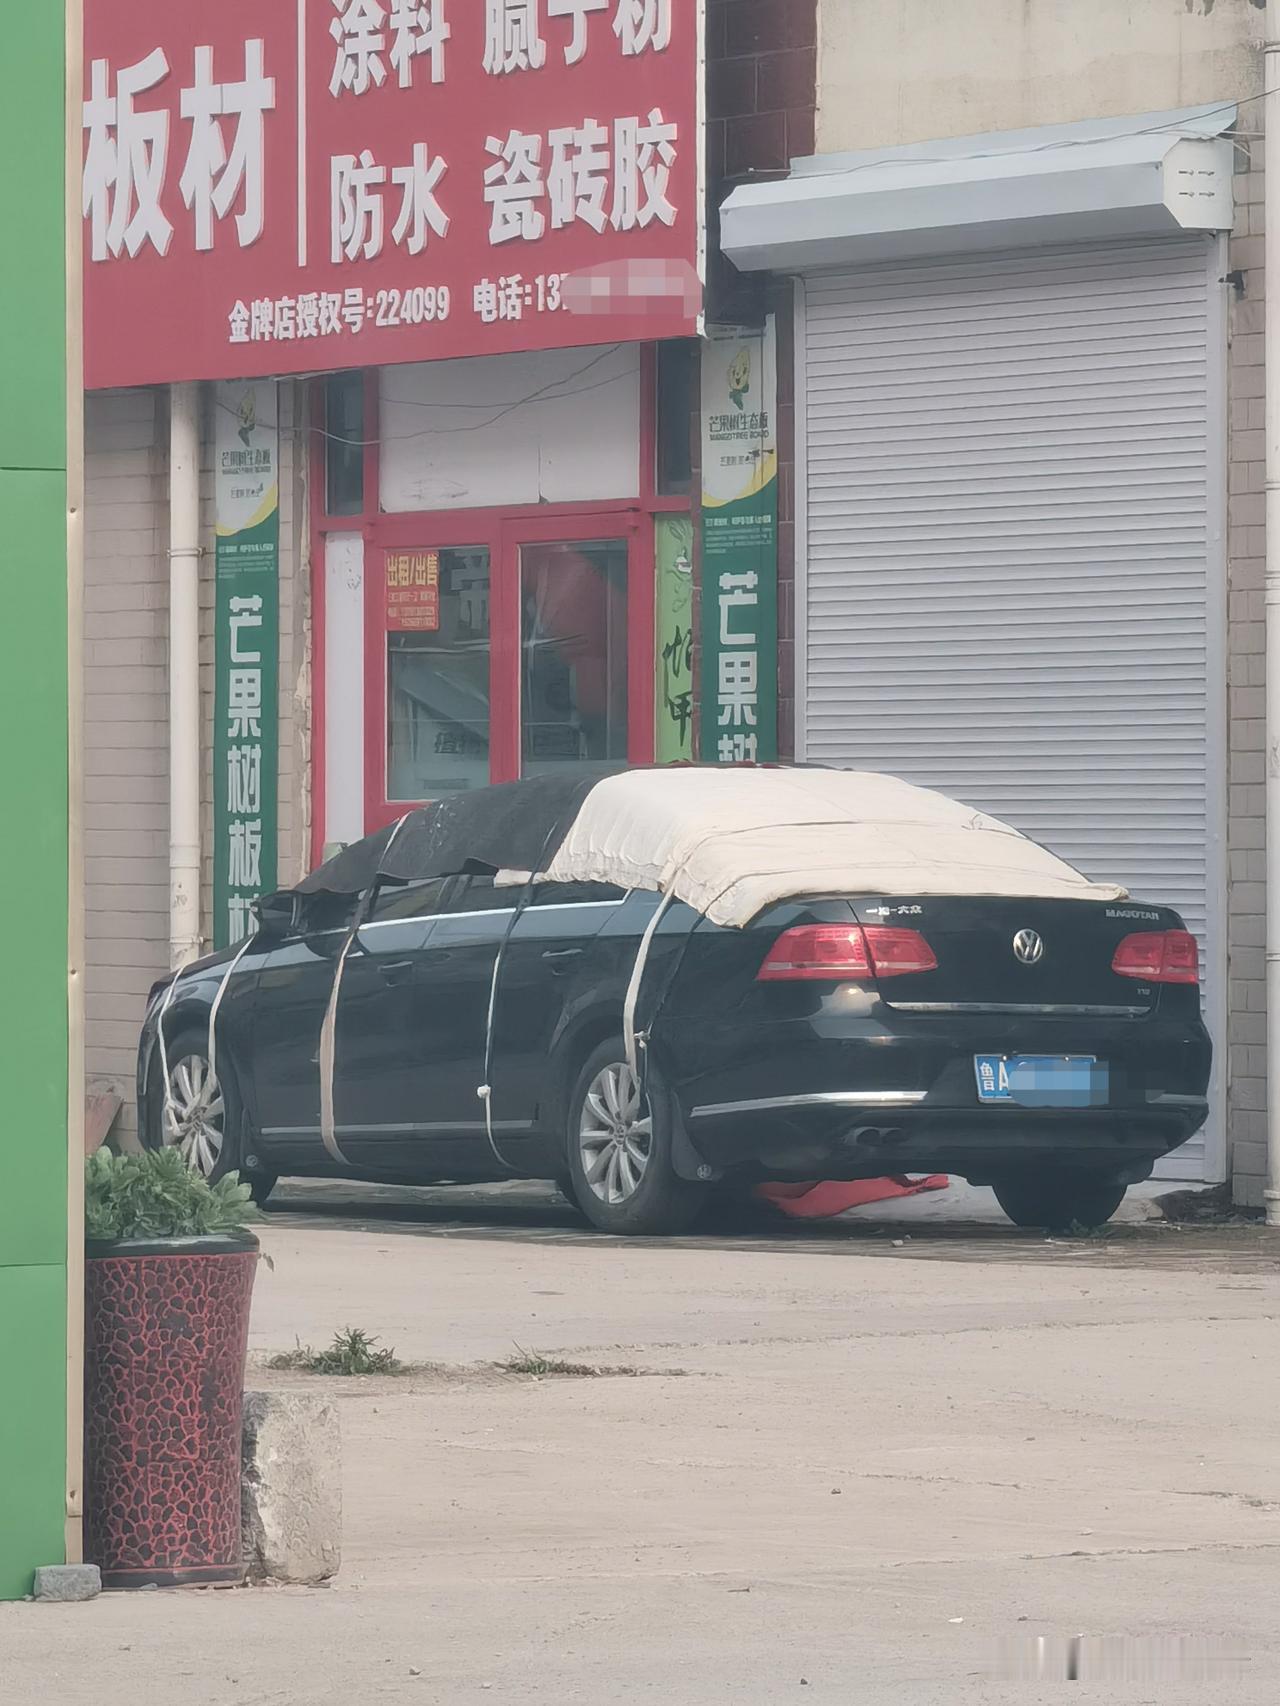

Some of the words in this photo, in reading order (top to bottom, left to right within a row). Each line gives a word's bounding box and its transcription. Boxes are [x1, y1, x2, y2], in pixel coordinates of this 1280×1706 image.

[328, 0, 451, 99] 涂料
[83, 38, 276, 262] 板材
[330, 142, 450, 264] 防水
[483, 107, 680, 246] 瓷砖胶
